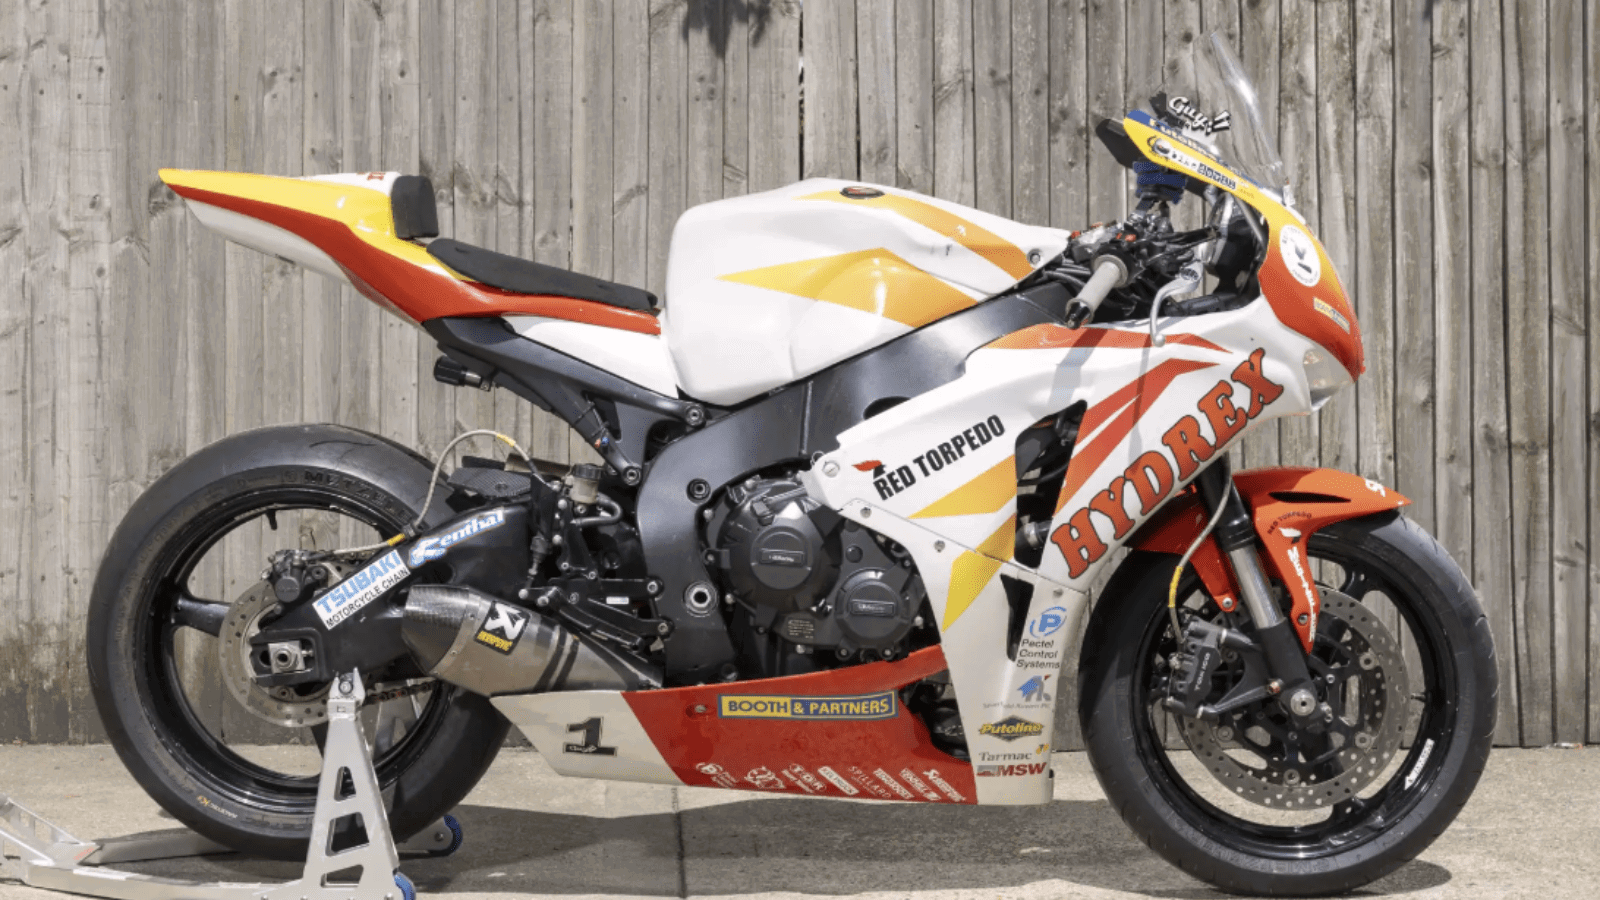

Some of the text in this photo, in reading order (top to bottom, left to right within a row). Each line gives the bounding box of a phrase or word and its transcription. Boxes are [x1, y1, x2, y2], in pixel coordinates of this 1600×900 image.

[873, 415, 1005, 500] RED TORPEDO
[1050, 347, 1284, 579] HYDREX
[410, 508, 505, 567] Renthal
[317, 551, 401, 613] TSUBAKI
[326, 568, 409, 628] MOTORCYCLE CHAIN
[1021, 638, 1055, 649] Pectel
[1019, 649, 1058, 659] Control
[1017, 659, 1060, 670] Systems
[727, 698, 890, 715] BOOTH & PARTNERS
[563, 716, 618, 758] 1
[980, 723, 1044, 735] Putoline
[979, 751, 1032, 762] Tarmac
[998, 762, 1047, 777] MSW
